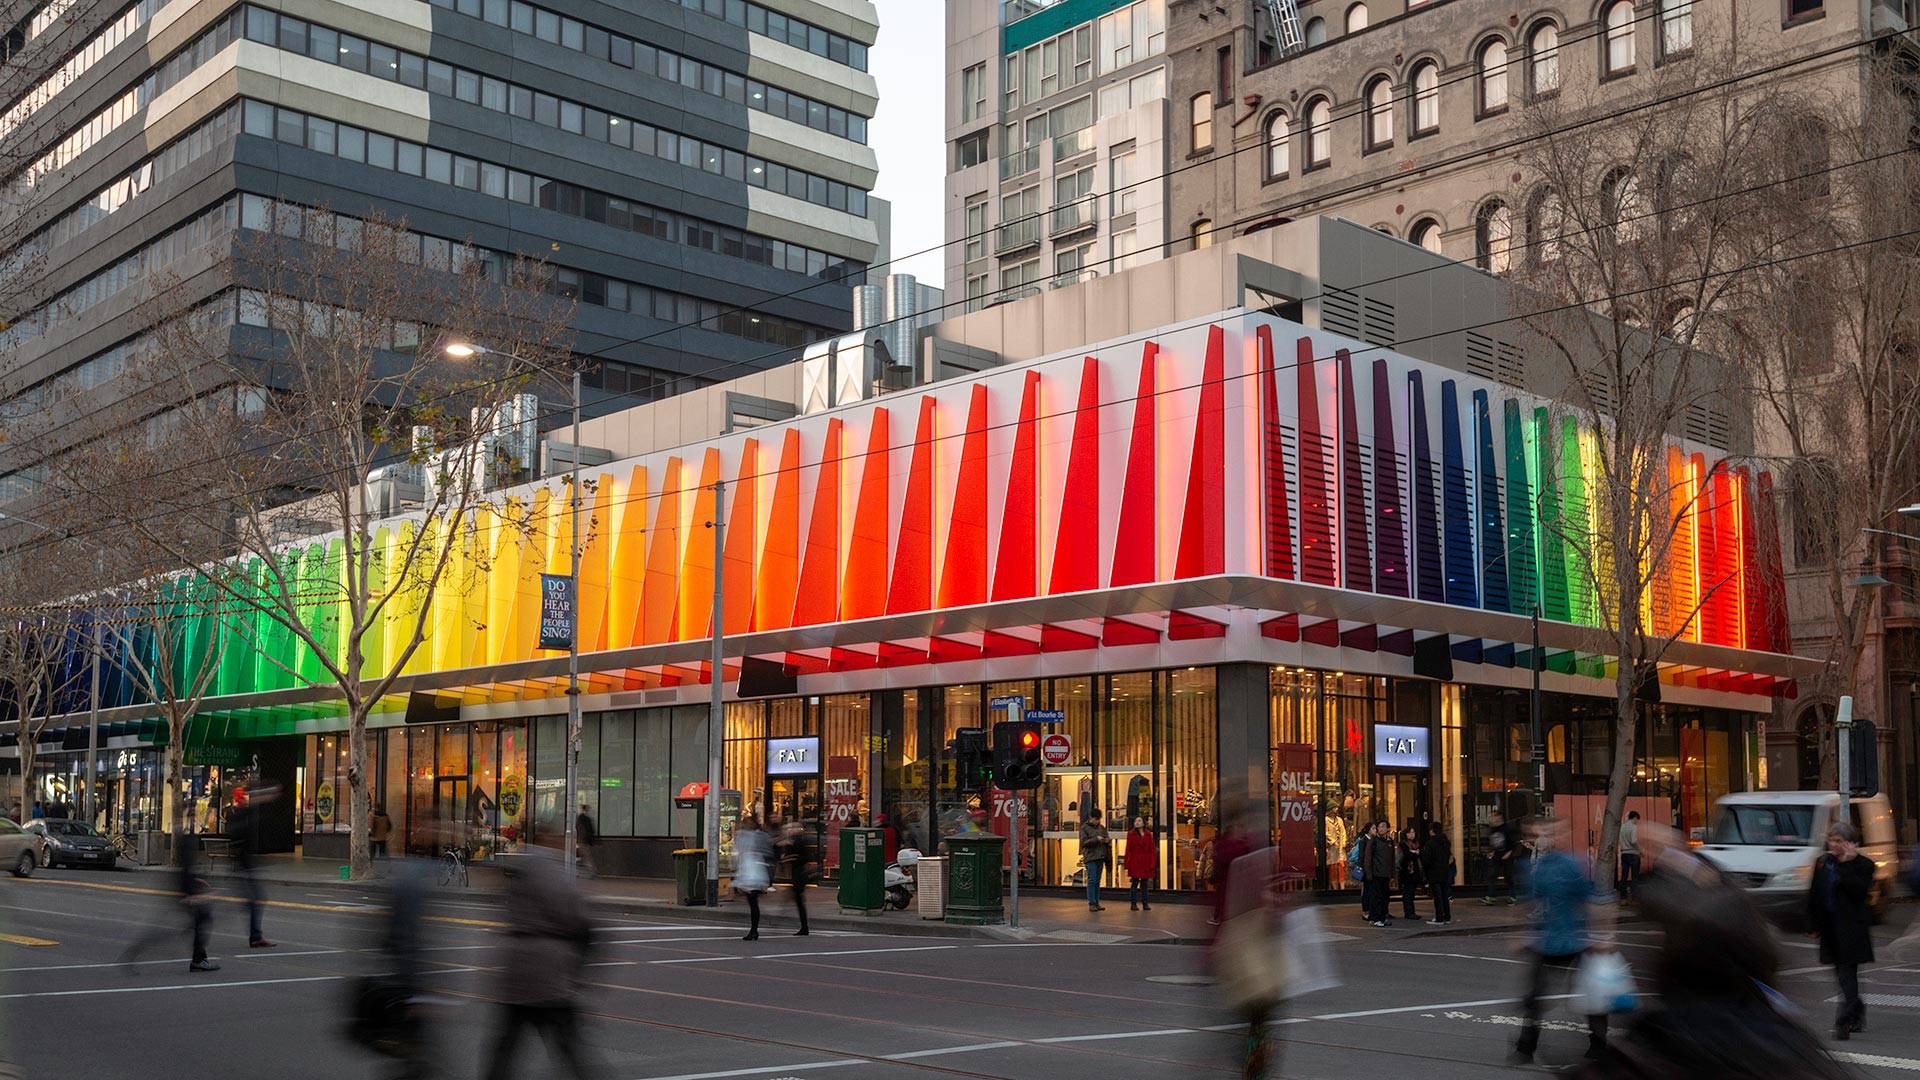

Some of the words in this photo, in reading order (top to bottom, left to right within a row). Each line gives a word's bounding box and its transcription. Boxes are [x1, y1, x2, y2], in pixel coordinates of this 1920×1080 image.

[548, 580, 565, 591] DO
[549, 591, 566, 600] YOU
[544, 599, 570, 611] HEAR
[551, 611, 564, 619] THE
[543, 618, 570, 628] PEOPLE
[542, 628, 570, 639] SING?
[1387, 737, 1416, 753] FAT
[778, 748, 807, 763] FAT
[1047, 752, 1067, 760] ENTRY
[1281, 771, 1311, 791] SALE
[830, 779, 857, 796] SALE
[1281, 801, 1312, 821] 70%
